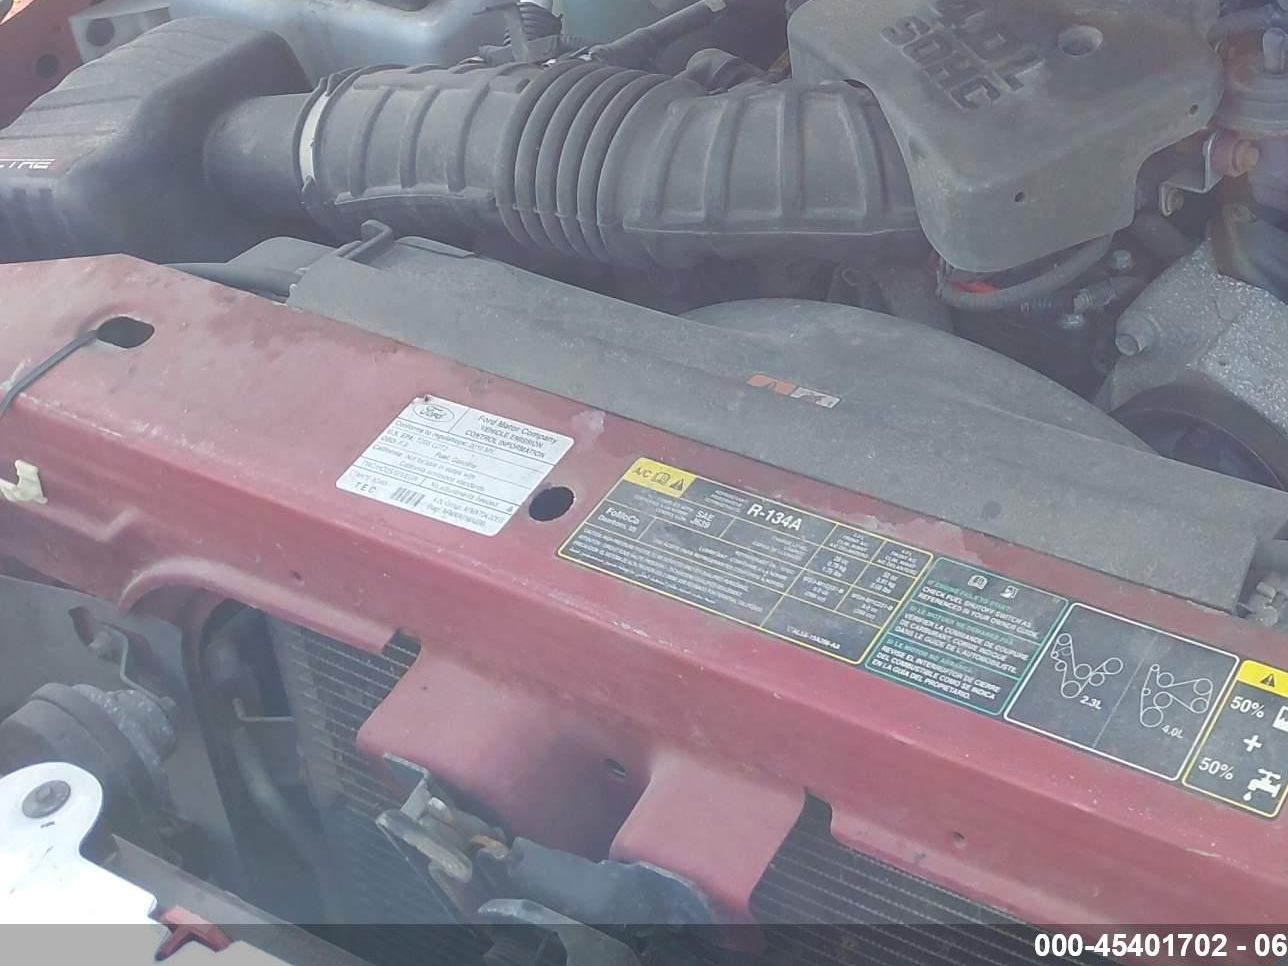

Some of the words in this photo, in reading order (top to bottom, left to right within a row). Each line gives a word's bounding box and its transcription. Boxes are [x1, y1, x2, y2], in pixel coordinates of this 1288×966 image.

[880, 16, 1001, 113] SOHC
[418, 404, 448, 419] Ford
[476, 415, 497, 424] Ford
[495, 421, 521, 432] Motor
[518, 428, 560, 444] Company
[463, 430, 498, 443] CONTROL
[496, 440, 547, 458] INFORMATION
[631, 466, 653, 478] A/C
[694, 510, 715, 521] SAE
[746, 503, 805, 530] R-134A
[917, 592, 962, 611] REFERENCED
[969, 610, 990, 621] YOUR
[989, 617, 1017, 630] OWNER
[921, 586, 946, 598] CHECK
[944, 594, 964, 604] FUEL
[962, 600, 995, 614] SHUTOFF
[994, 611, 1022, 624] SWITCH
[893, 626, 914, 637] DANS
[922, 636, 945, 648] GUIDE
[908, 623, 952, 642] CARBURANT
[951, 638, 978, 651] COMME
[942, 627, 984, 645] COMMANDE
[992, 644, 1029, 661] COUPURE
[875, 652, 891, 661] DEL
[889, 657, 939, 679] COMBUSTIBLE
[937, 674, 961, 687] COMO
[970, 686, 995, 699] INDICA
[880, 645, 906, 658] REVISE
[914, 657, 964, 679] INTERRUPTOR
[972, 679, 1001, 693] CIERRE
[909, 673, 924, 682] DEL
[1079, 695, 1103, 710] 2.3L
[1230, 695, 1265, 719] 50%
[1161, 724, 1185, 740] 4.0L
[1197, 756, 1235, 782] 50%
